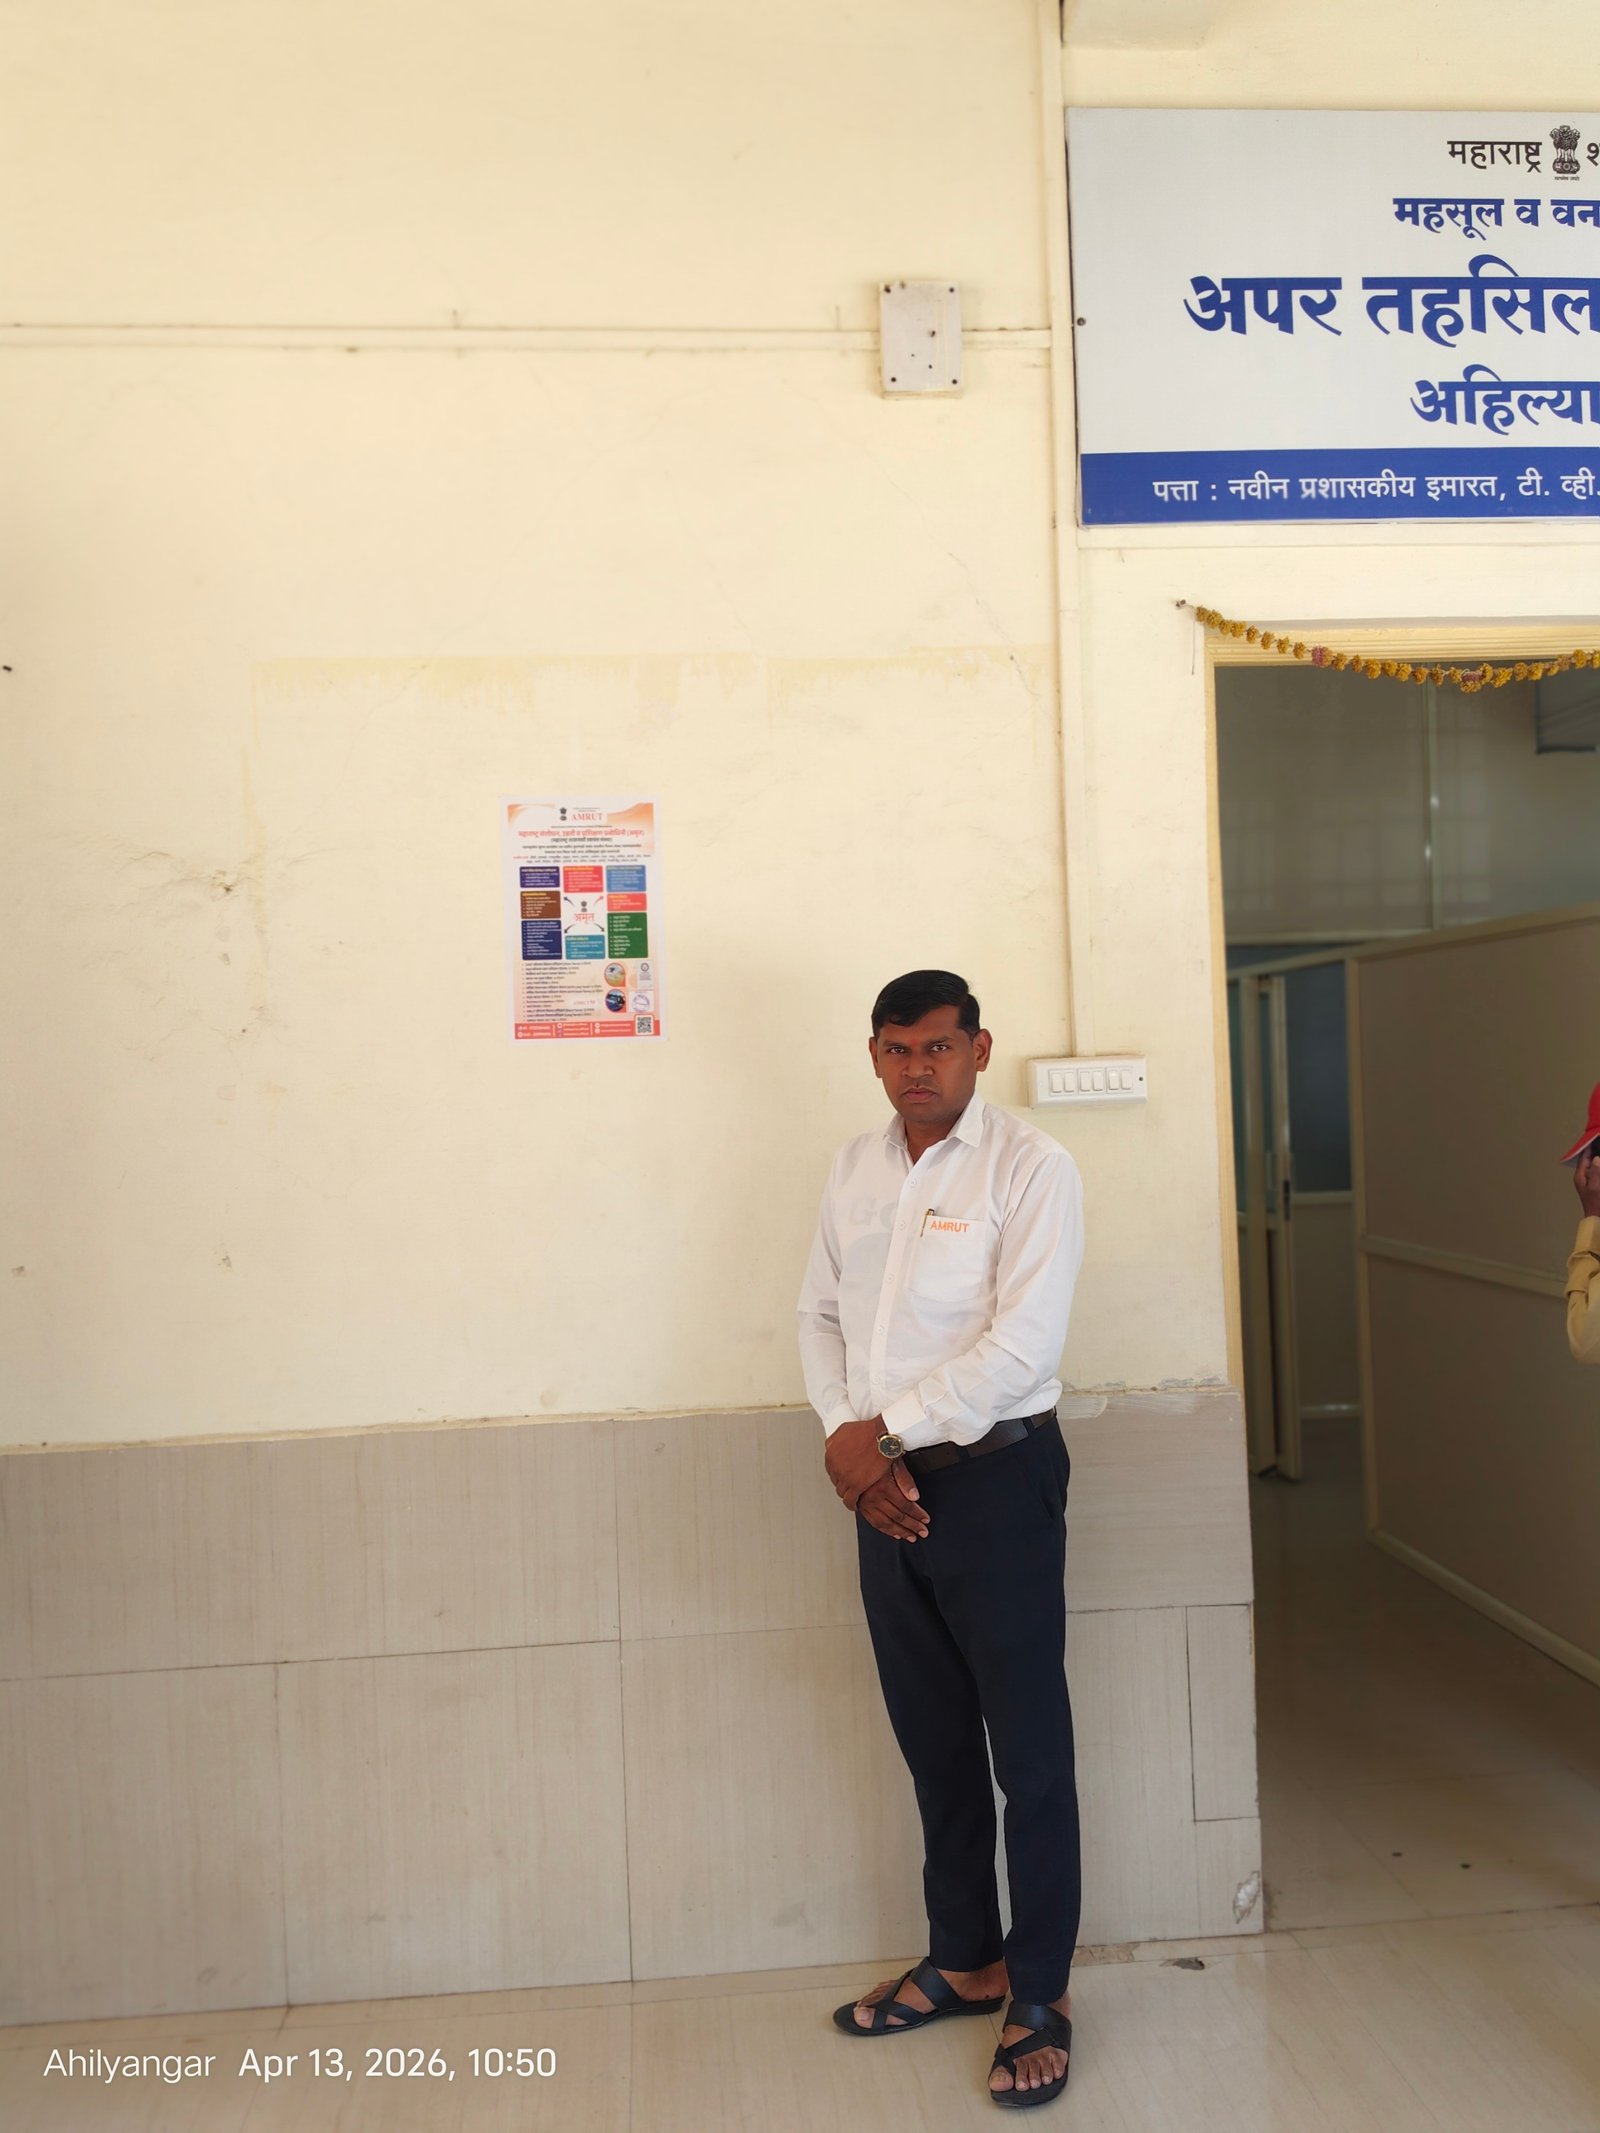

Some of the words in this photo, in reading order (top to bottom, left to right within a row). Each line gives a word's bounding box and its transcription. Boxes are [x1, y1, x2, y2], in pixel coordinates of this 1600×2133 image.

[1446, 140, 1543, 173] महाराष्ट्र
[1393, 198, 1505, 241] महसूल
[1514, 198, 1542, 228] व
[1550, 199, 1600, 229] वन
[1183, 275, 1343, 337] अपर
[1361, 253, 1600, 349] तहसिल
[1410, 363, 1600, 437] अहिल्या
[1152, 480, 1199, 502] पत्ता
[1227, 470, 1290, 500] नवीन
[1299, 468, 1417, 499] प्रशासकीय
[1424, 476, 1506, 502] इमारत,
[1516, 466, 1550, 497] टी.
[571, 812, 603, 821] AMRUT
[574, 912, 595, 925] अमृत
[930, 1219, 970, 1233] AMRUT
